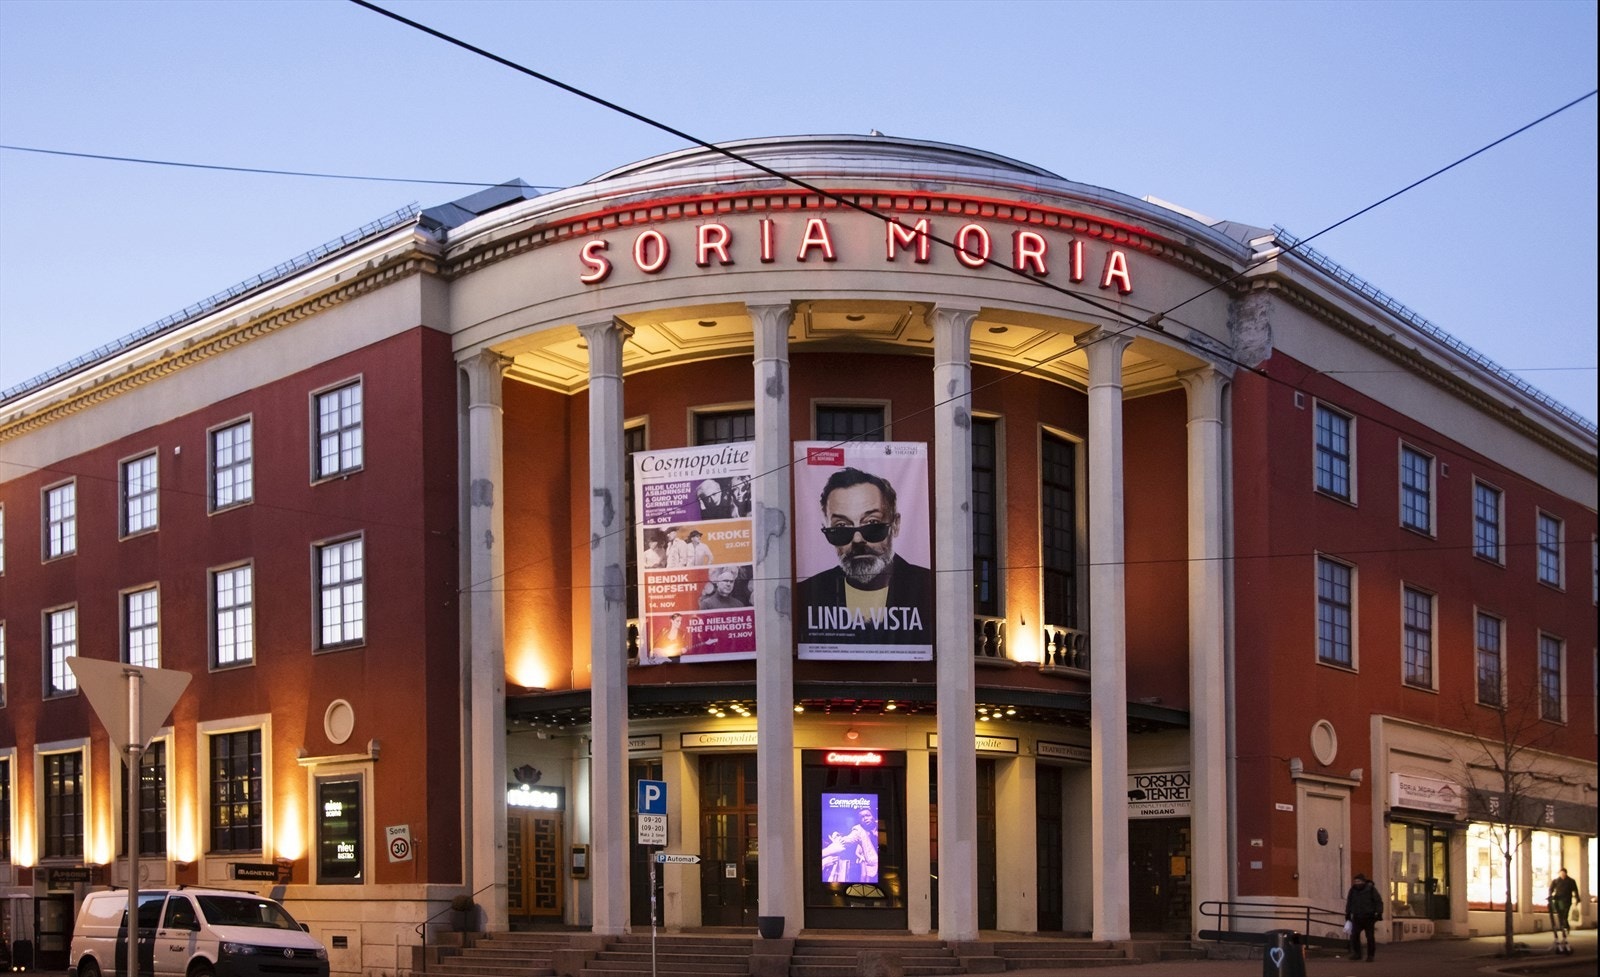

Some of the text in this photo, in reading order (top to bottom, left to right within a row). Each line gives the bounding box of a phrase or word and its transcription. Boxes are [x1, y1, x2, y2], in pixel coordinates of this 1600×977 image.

[579, 217, 1134, 295] SORIA MORIA
[640, 445, 749, 475] Cosmopolite
[645, 482, 691, 492] HILDE LOUISE
[645, 500, 684, 508] GERMETEN
[707, 530, 750, 541] KROKE
[647, 574, 689, 584] BENDIK
[647, 583, 698, 594] HOFSETH
[689, 618, 704, 626] IDA
[707, 616, 744, 624] NIELSEN
[807, 606, 923, 631] LINDA VISTA
[686, 623, 752, 633] THE FUNKBOTS
[699, 734, 757, 744] Cosmopolite
[976, 738, 1002, 749] polite
[645, 785, 661, 810] P
[1145, 786, 1191, 801] TEATRET
[1140, 808, 1175, 816] INNGANG
[337, 841, 354, 852] nieu
[393, 842, 406, 854] 30
[237, 868, 275, 877] MAGNETEN
